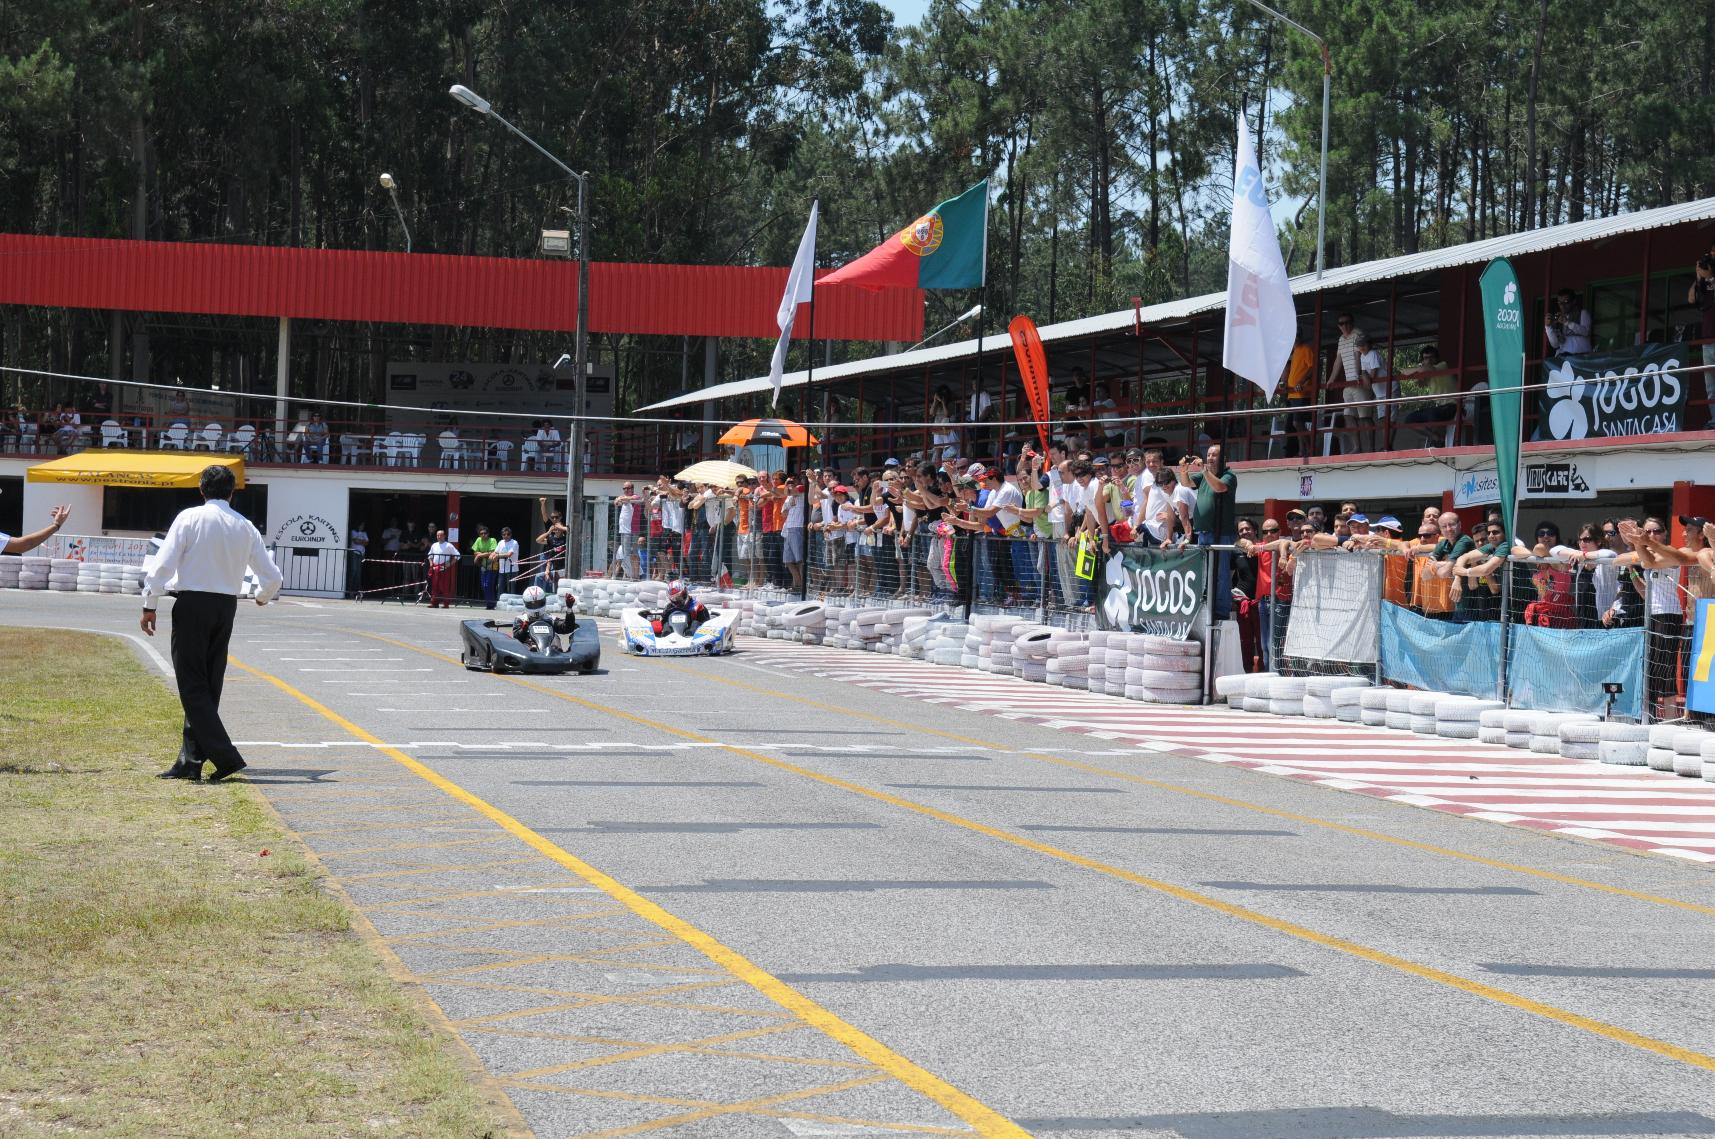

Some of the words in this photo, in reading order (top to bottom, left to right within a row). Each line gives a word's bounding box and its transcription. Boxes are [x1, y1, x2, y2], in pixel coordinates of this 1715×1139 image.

[1592, 358, 1681, 431] JOGOS
[1527, 466, 1545, 490] VIRUS
[275, 514, 303, 541] ESCOLA
[308, 514, 340, 543] KARTING
[1133, 569, 1196, 625] JOGOS
